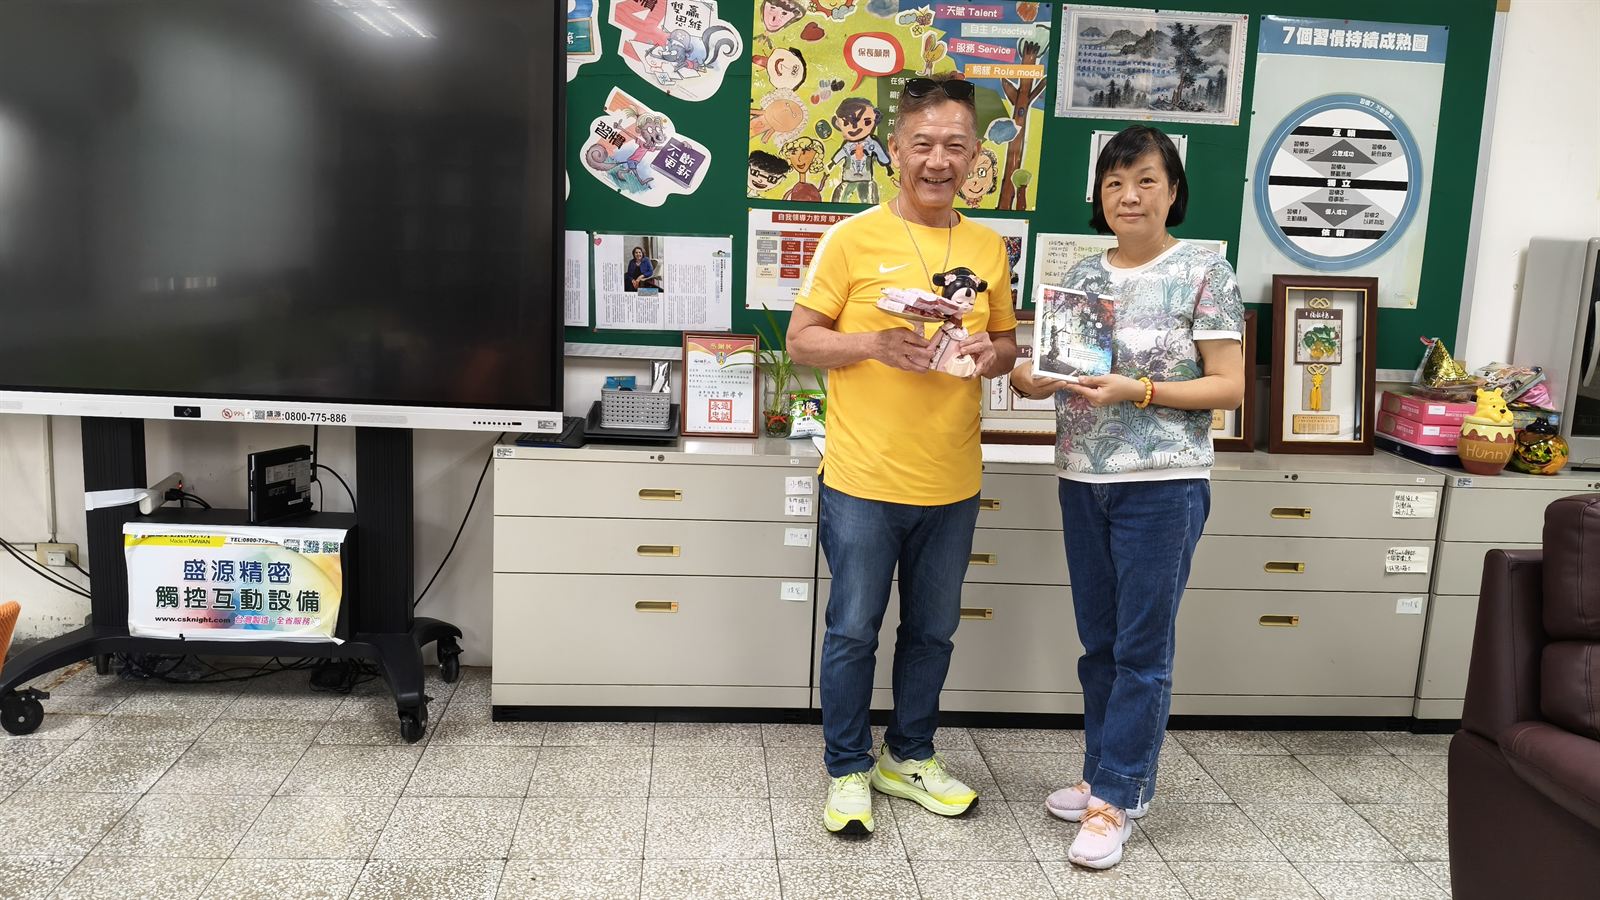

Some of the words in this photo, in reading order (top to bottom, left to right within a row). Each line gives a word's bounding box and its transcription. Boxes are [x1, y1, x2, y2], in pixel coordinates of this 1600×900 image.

[671, 2, 699, 18] 雙贏
[946, 5, 966, 17] 天賦
[968, 8, 998, 18] Talent
[675, 15, 702, 31] 思維
[970, 25, 989, 35] 自主
[991, 27, 1034, 37] Proactive
[1282, 26, 1429, 53] 7個習慣持續成熟圖
[956, 42, 975, 53] 服務
[978, 45, 1011, 55] Service
[993, 67, 1014, 76] Role
[1016, 68, 1044, 77] model
[594, 120, 626, 149] 習慣
[1293, 140, 1310, 148] 習慣5
[1371, 143, 1387, 151] 習慣6
[667, 143, 696, 167] 不斷
[664, 155, 692, 179] 更新
[1327, 178, 1352, 188] 獨立
[1321, 228, 1345, 237] 依賴
[711, 401, 730, 411] 永遠
[711, 411, 731, 421] 忠誠
[1466, 444, 1512, 461] Hunny
[183, 559, 291, 584] 盛源精密
[155, 585, 320, 613] 觸控互動設備
[155, 615, 231, 624] www.csknight.com
[276, 617, 311, 626] 全省服務
